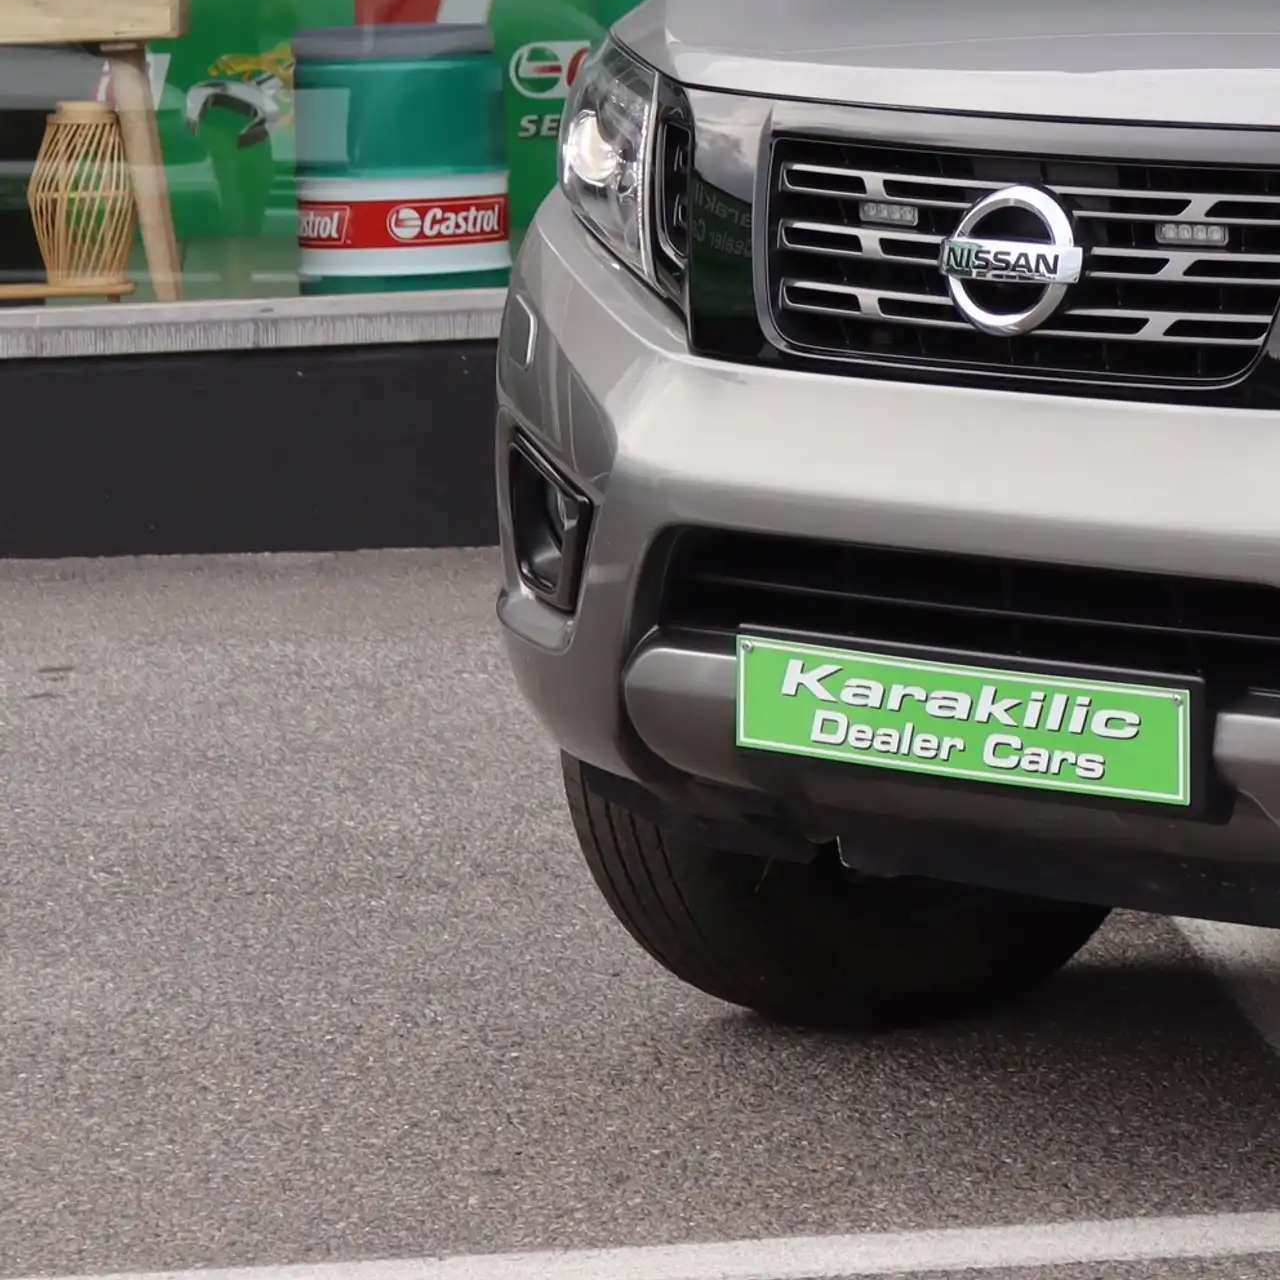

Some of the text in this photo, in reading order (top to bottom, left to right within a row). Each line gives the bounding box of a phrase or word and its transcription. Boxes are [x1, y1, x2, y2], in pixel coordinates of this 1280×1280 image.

[423, 204, 499, 238] Castrol
[945, 247, 1060, 275] NISSAN
[780, 658, 1142, 740] Karakilic
[809, 709, 1106, 781] Dealer Cars
